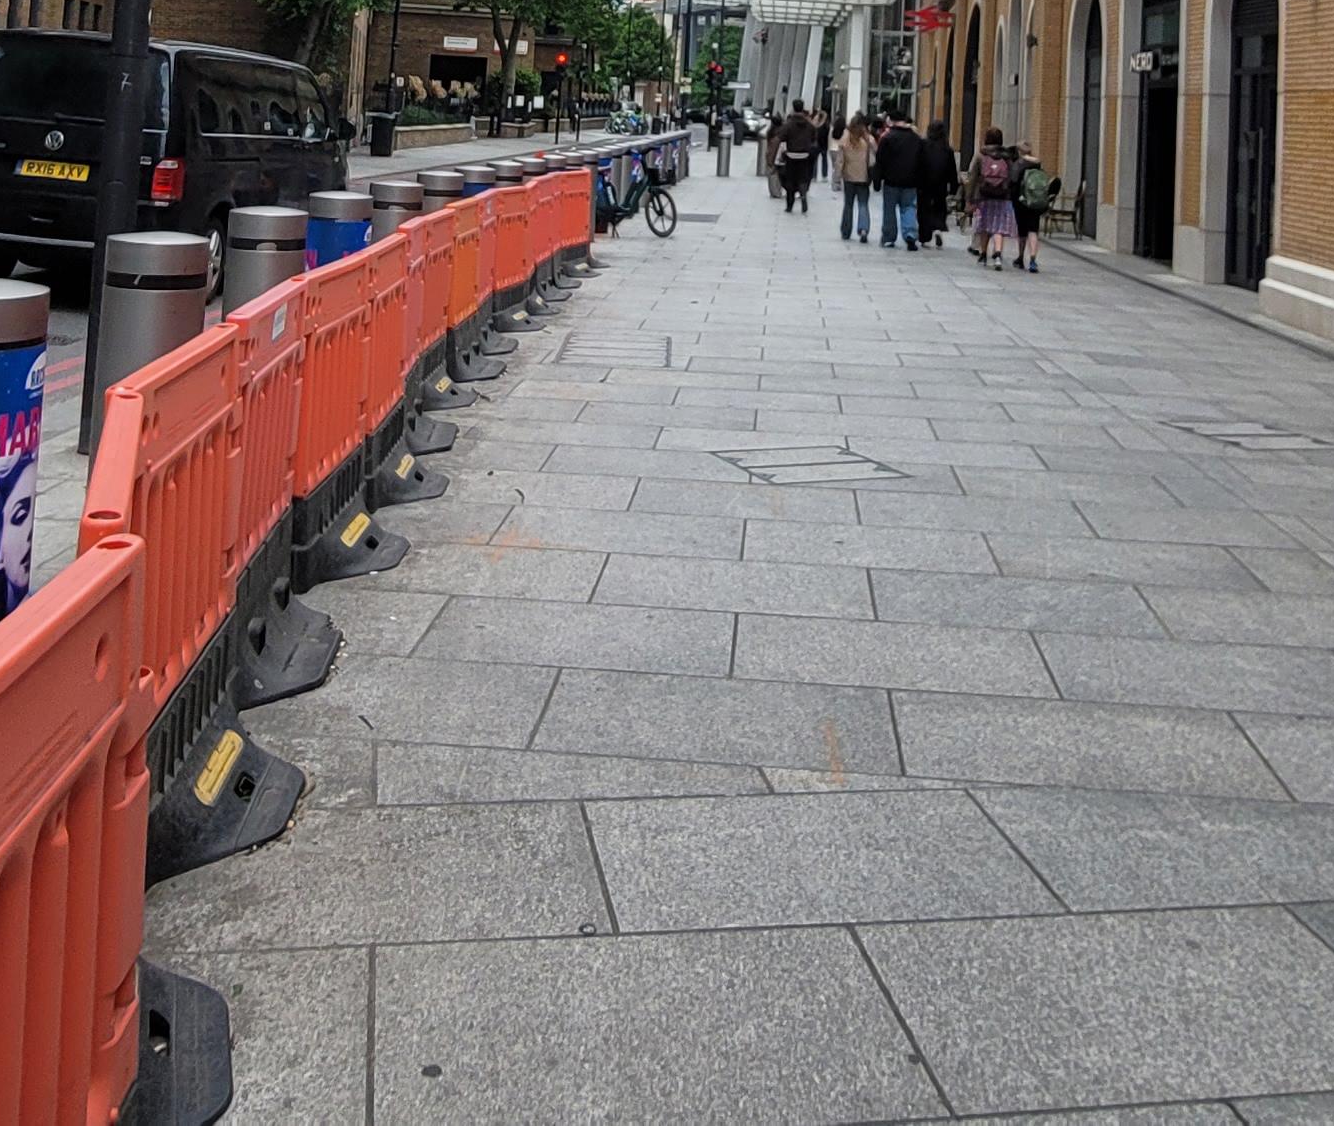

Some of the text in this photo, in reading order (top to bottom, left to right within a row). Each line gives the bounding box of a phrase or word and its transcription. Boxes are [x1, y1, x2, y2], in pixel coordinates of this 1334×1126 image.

[1129, 50, 1153, 72] NERO
[26, 162, 85, 179] RX16 AXV
